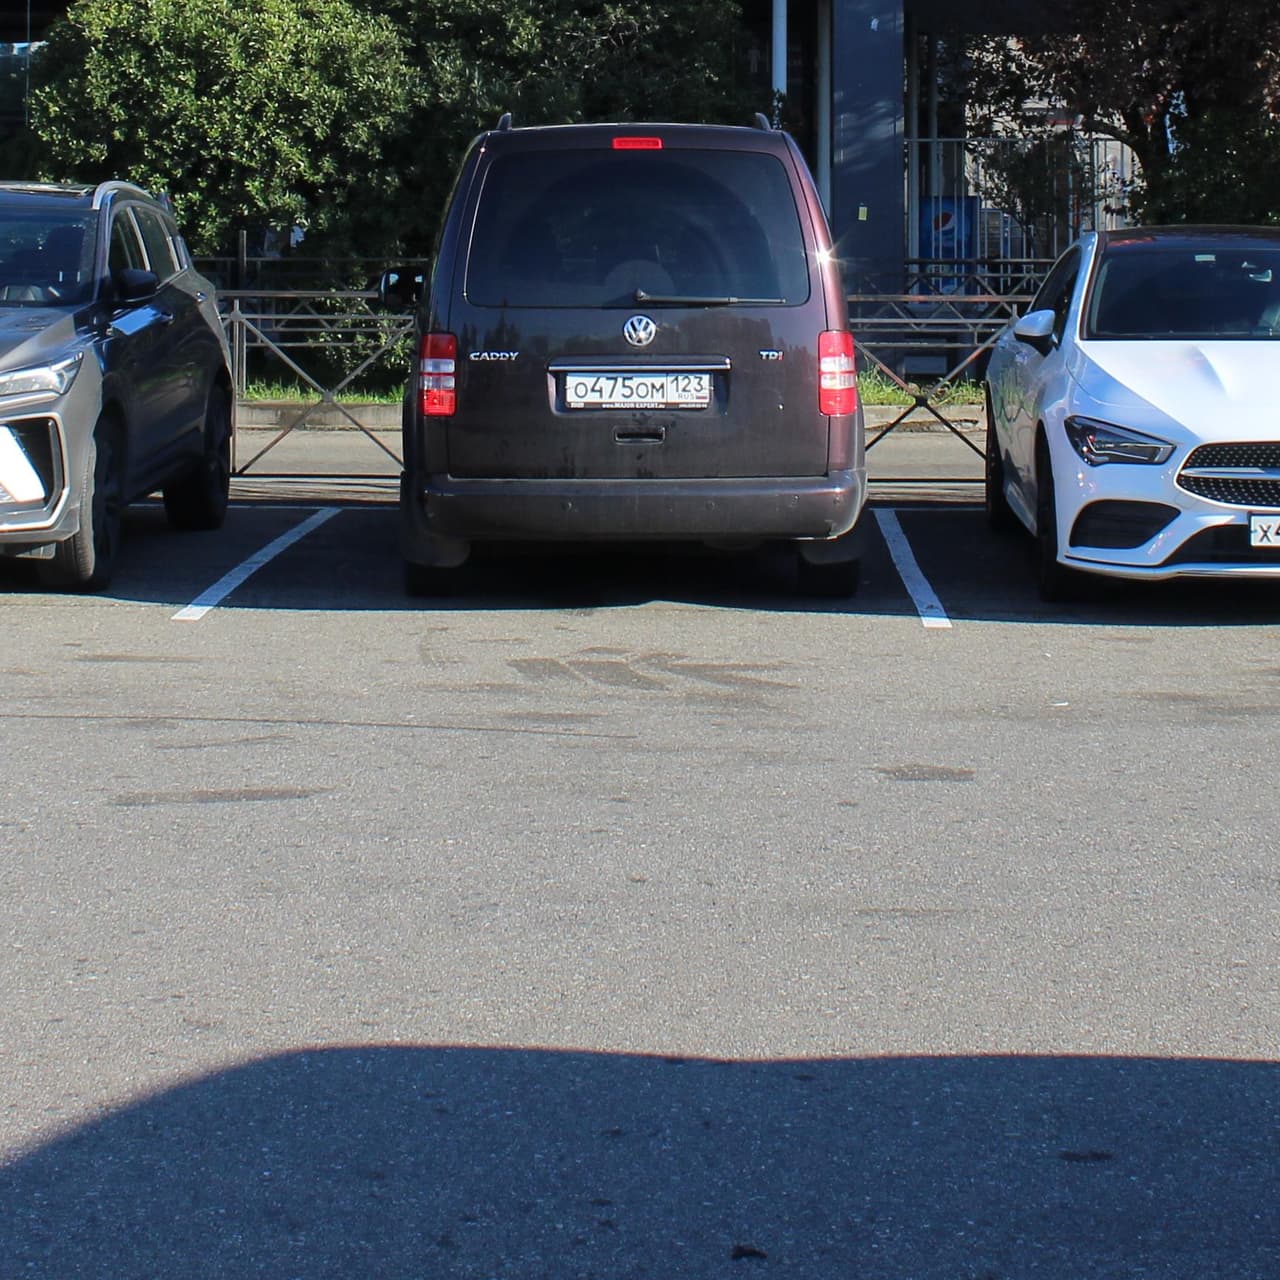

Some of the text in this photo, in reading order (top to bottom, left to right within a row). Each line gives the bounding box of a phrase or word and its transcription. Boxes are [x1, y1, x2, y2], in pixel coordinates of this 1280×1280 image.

[469, 351, 519, 361] CADDY
[574, 375, 705, 399] О475ОМ 123
